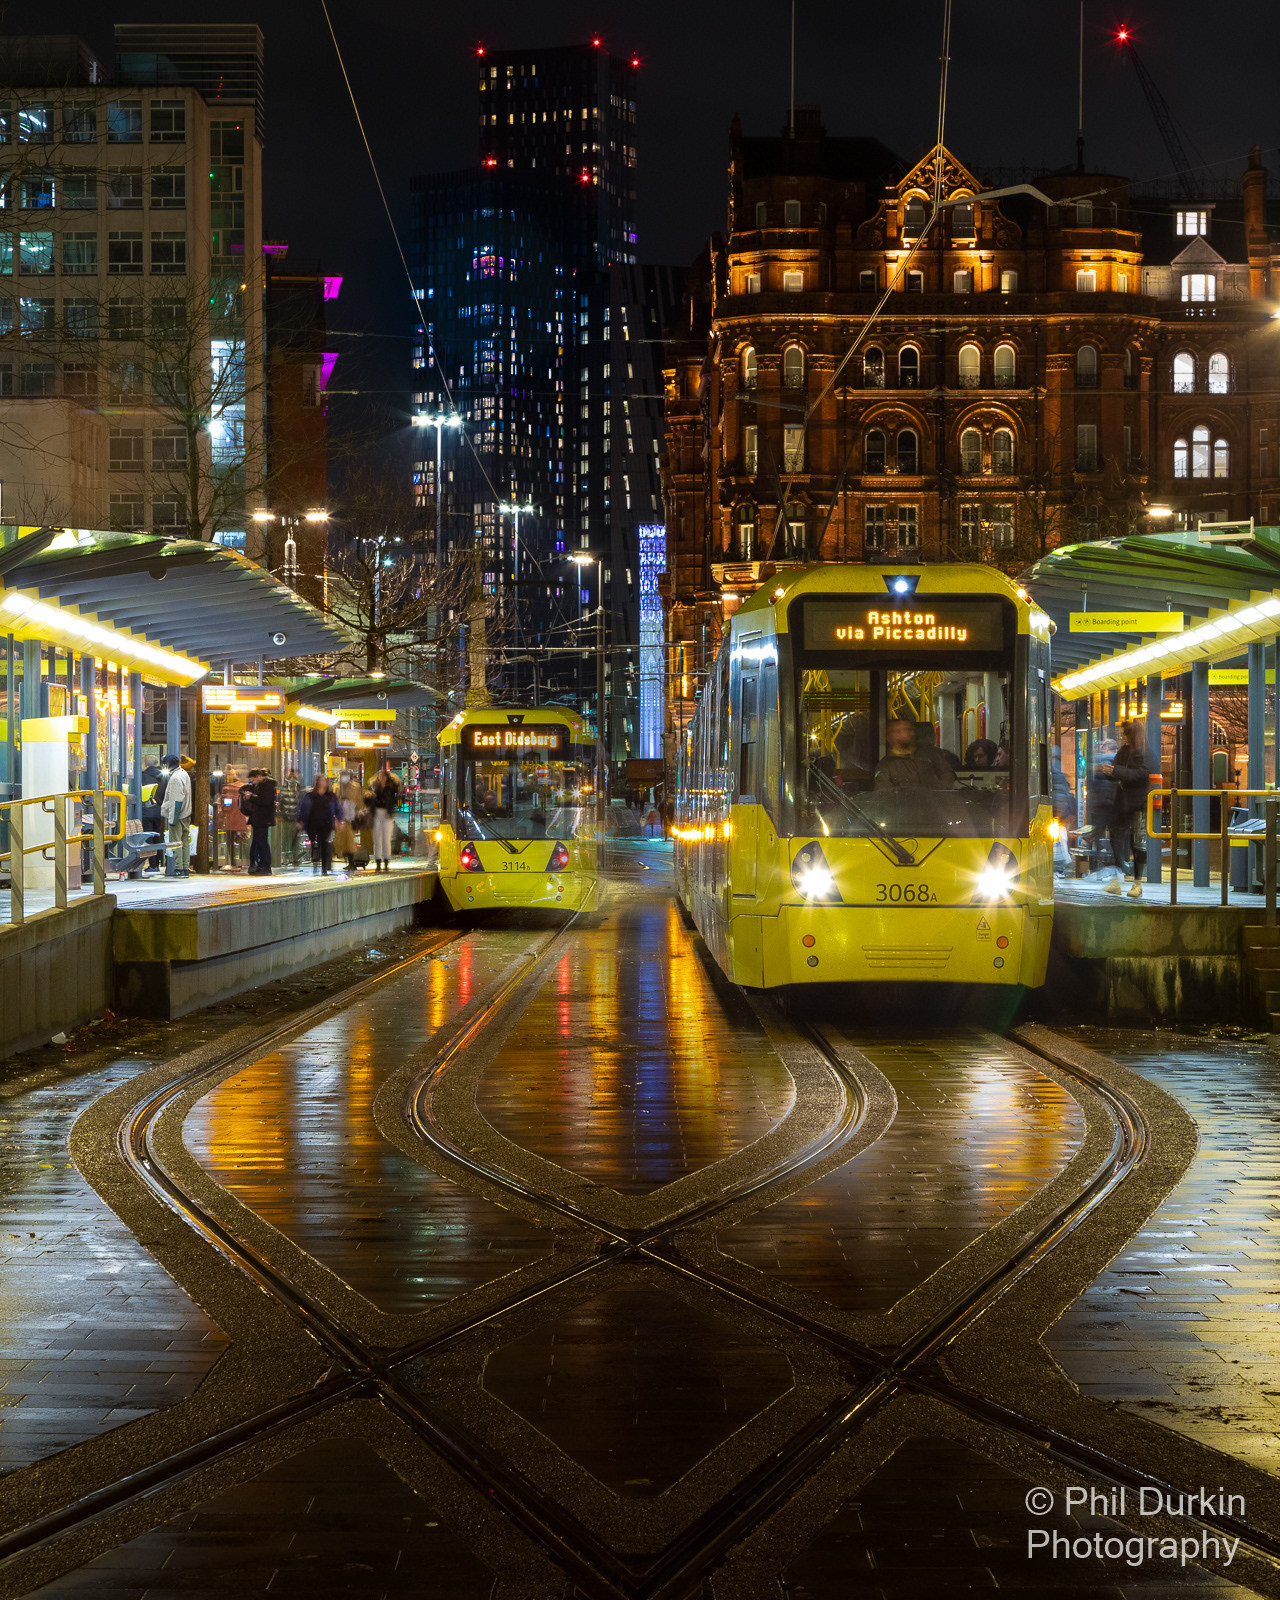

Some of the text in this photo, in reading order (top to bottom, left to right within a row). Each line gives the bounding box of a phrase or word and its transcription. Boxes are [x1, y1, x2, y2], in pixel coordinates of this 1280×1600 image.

[868, 611, 935, 624] Ashton
[1092, 618, 1120, 626] Boarding
[836, 626, 967, 641] via Piccadilly
[474, 731, 557, 748] East Didsbury
